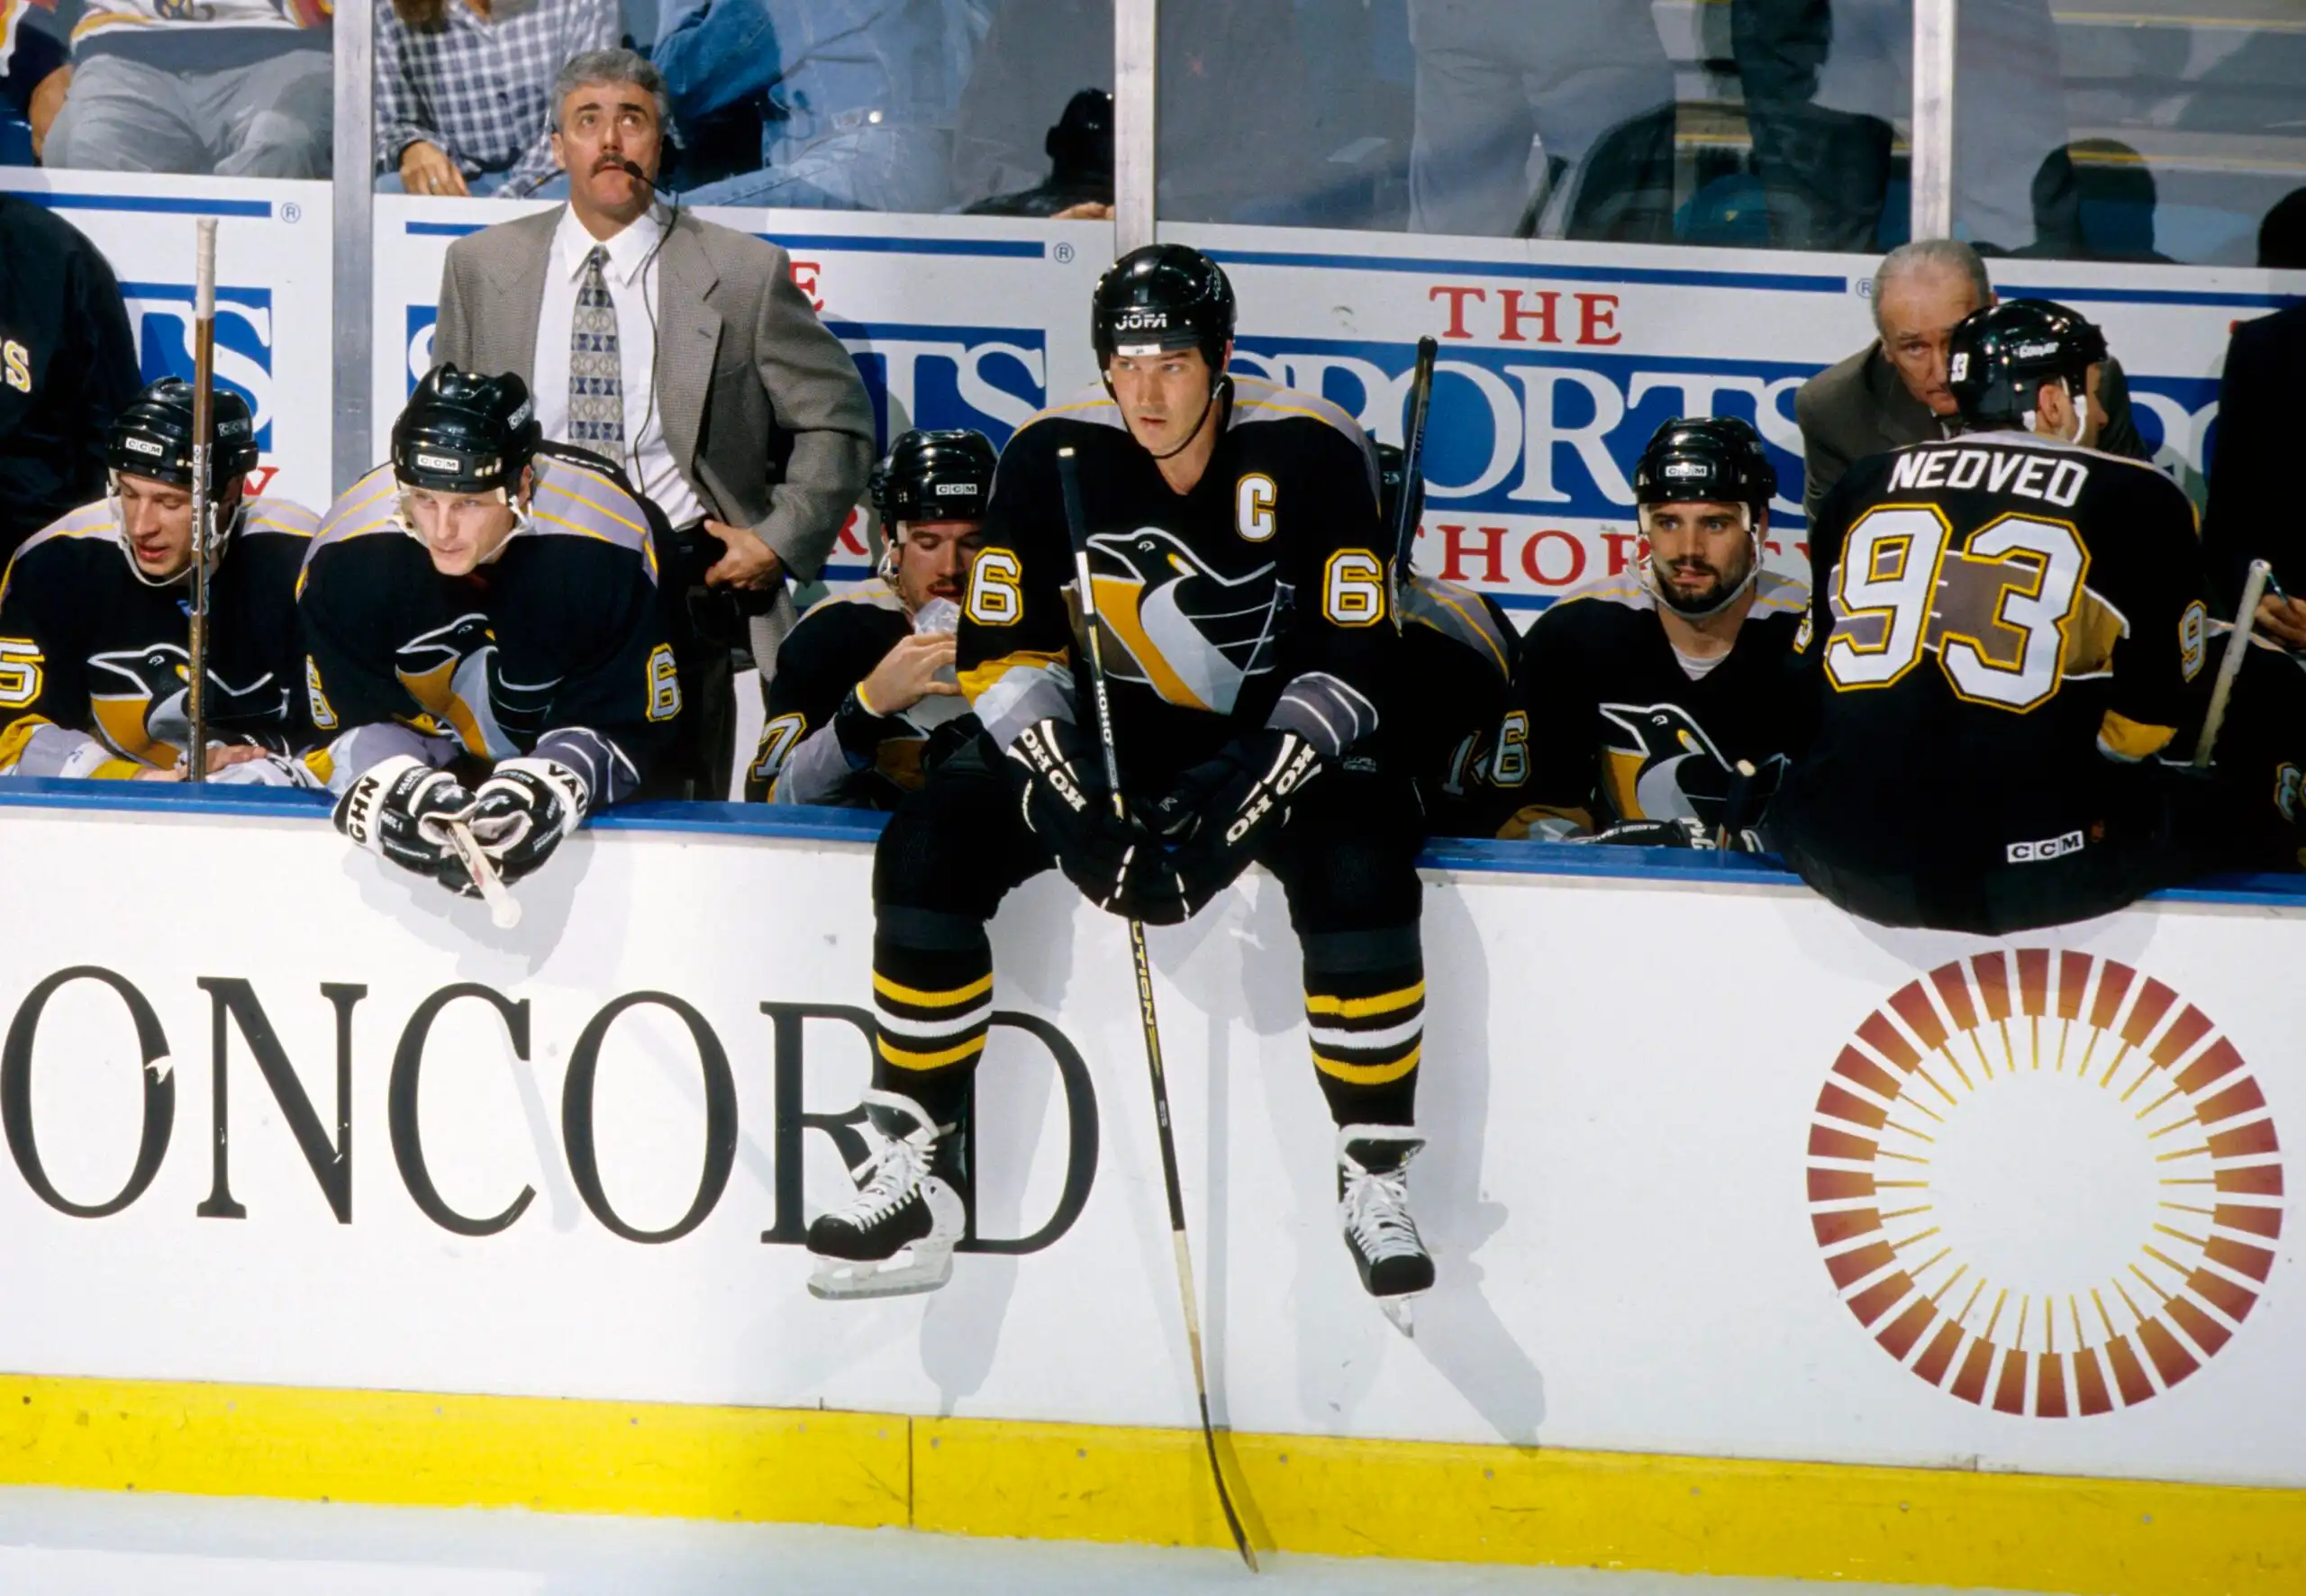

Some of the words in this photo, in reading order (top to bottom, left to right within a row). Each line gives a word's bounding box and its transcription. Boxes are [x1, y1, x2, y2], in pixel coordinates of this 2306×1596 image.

[1115, 313, 1168, 331] JOFA
[1430, 286, 1621, 346] THE
[127, 439, 162, 456] CCM
[419, 455, 458, 470] CCM
[1887, 449, 2089, 507] NEDVED
[937, 484, 978, 494] CCM
[1235, 472, 1277, 542] C
[1322, 548, 1387, 628] 6
[1823, 503, 2092, 715] 93
[1095, 679, 1114, 744] KOHO
[348, 775, 380, 844] GHN
[1226, 742, 1317, 845] KOHO
[2009, 830, 2084, 862] CCM
[0, 965, 1100, 1256] ONCORD
